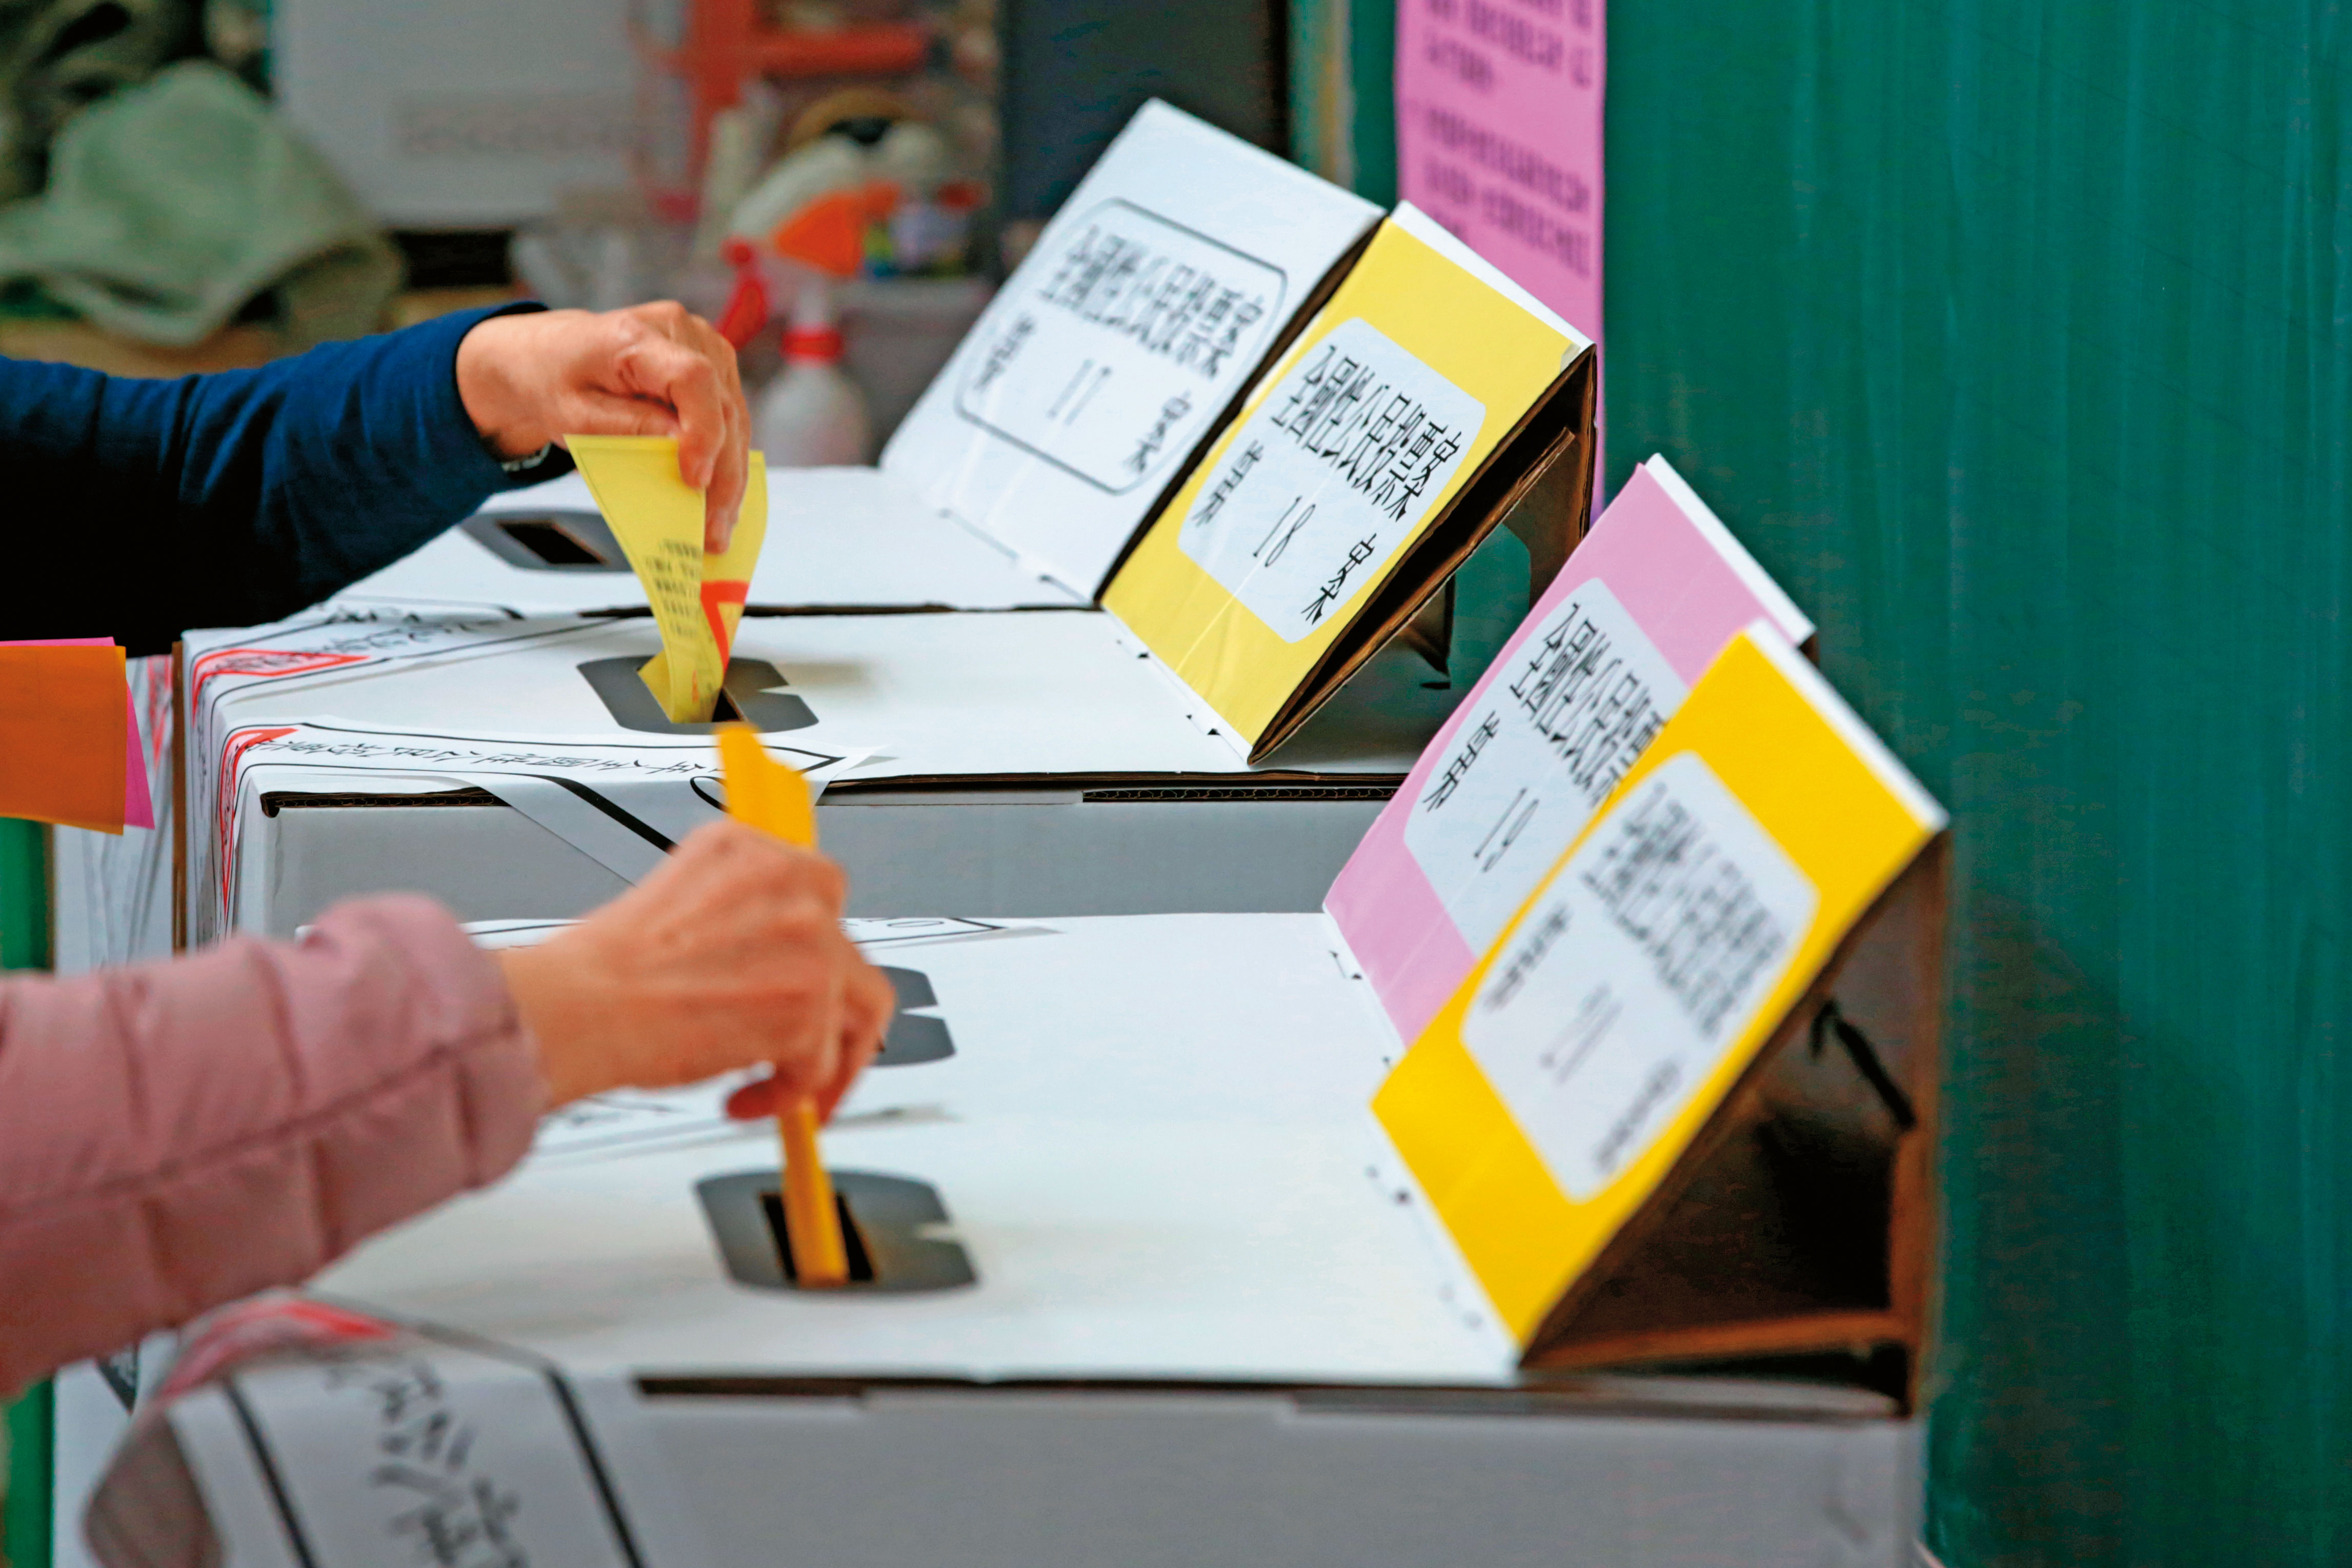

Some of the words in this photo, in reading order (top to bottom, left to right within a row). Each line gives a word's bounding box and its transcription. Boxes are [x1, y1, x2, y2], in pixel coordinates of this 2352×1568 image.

[1271, 345, 1461, 521] 全國性公民投票案
[1193, 439, 1264, 527] 第
[1253, 496, 1316, 567] 18
[1301, 533, 1377, 625] 案
[1423, 710, 1500, 812] 第
[1474, 787, 1540, 873] 19
